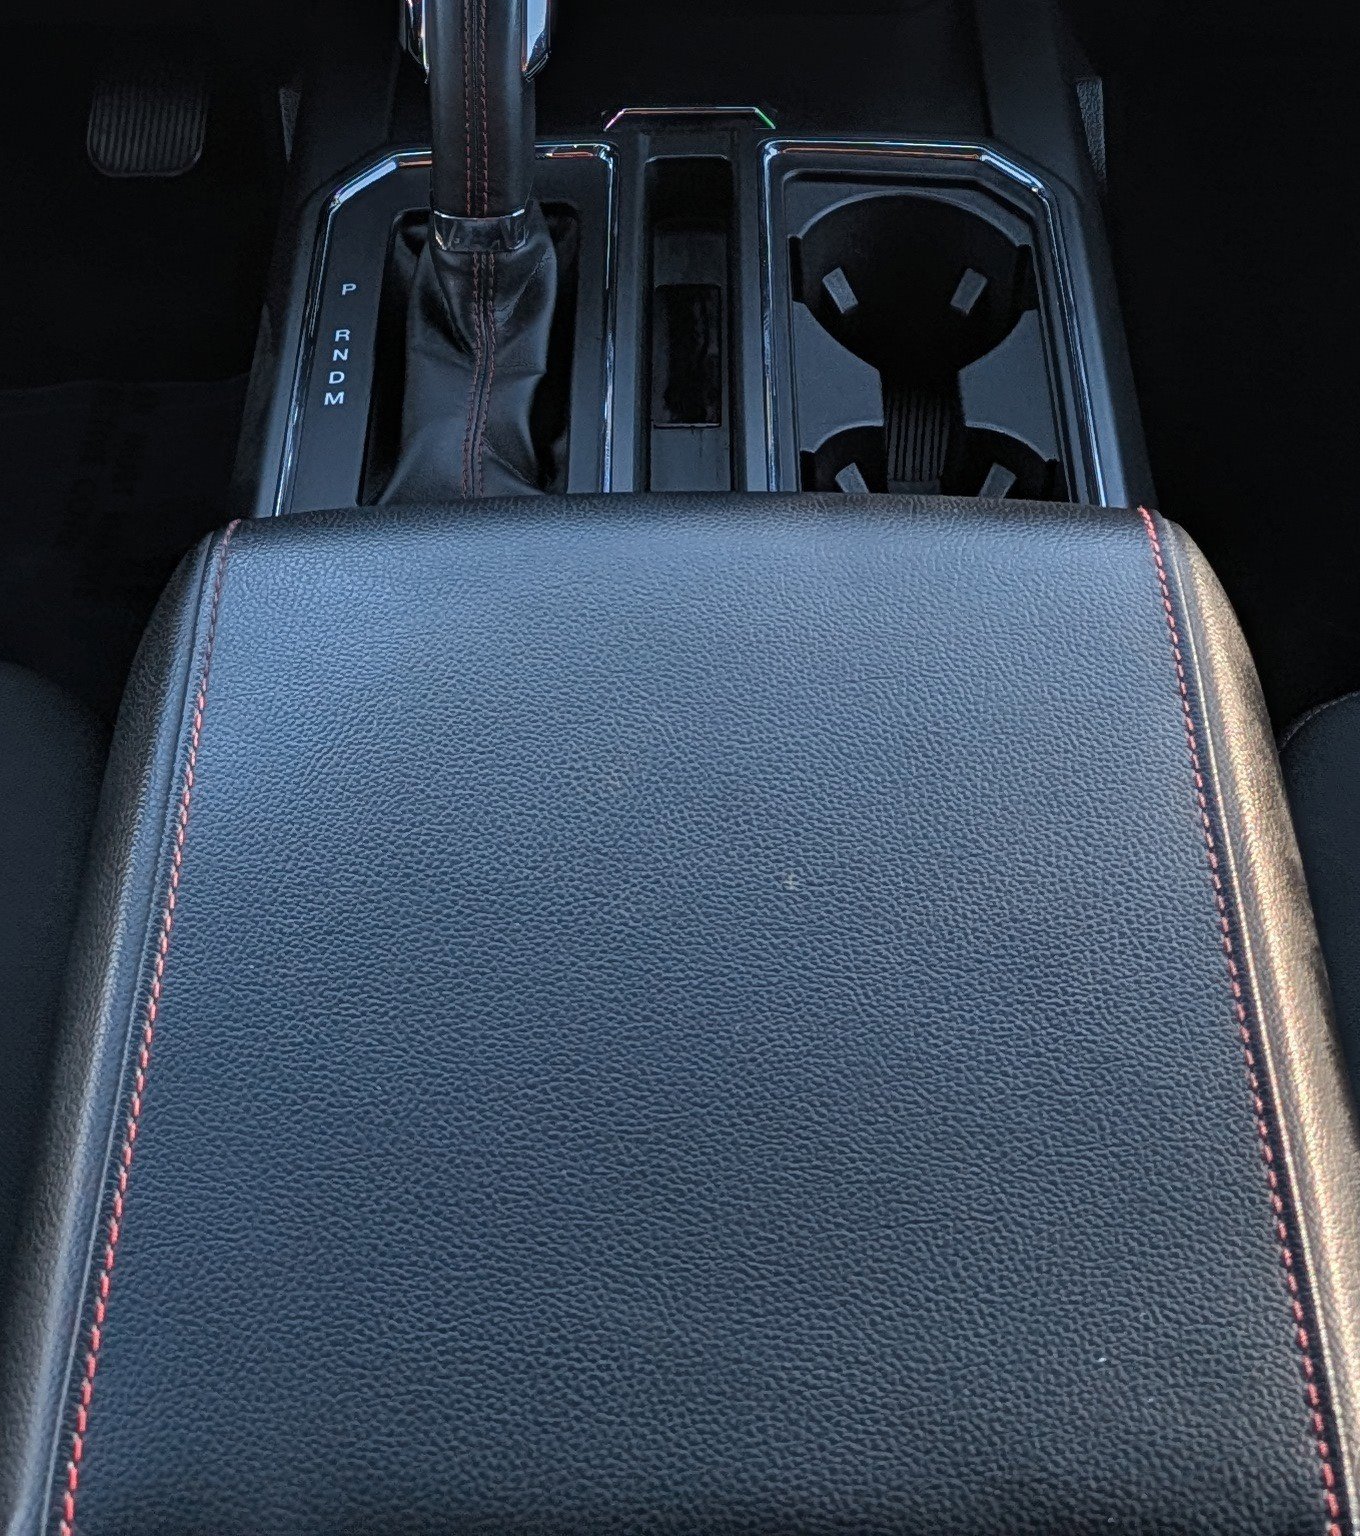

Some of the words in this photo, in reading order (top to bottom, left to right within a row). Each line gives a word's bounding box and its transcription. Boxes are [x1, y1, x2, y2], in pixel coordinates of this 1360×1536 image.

[341, 283, 357, 296] P
[335, 329, 351, 342] R
[333, 348, 349, 361] N
[329, 371, 344, 384] D
[324, 392, 344, 405] M
